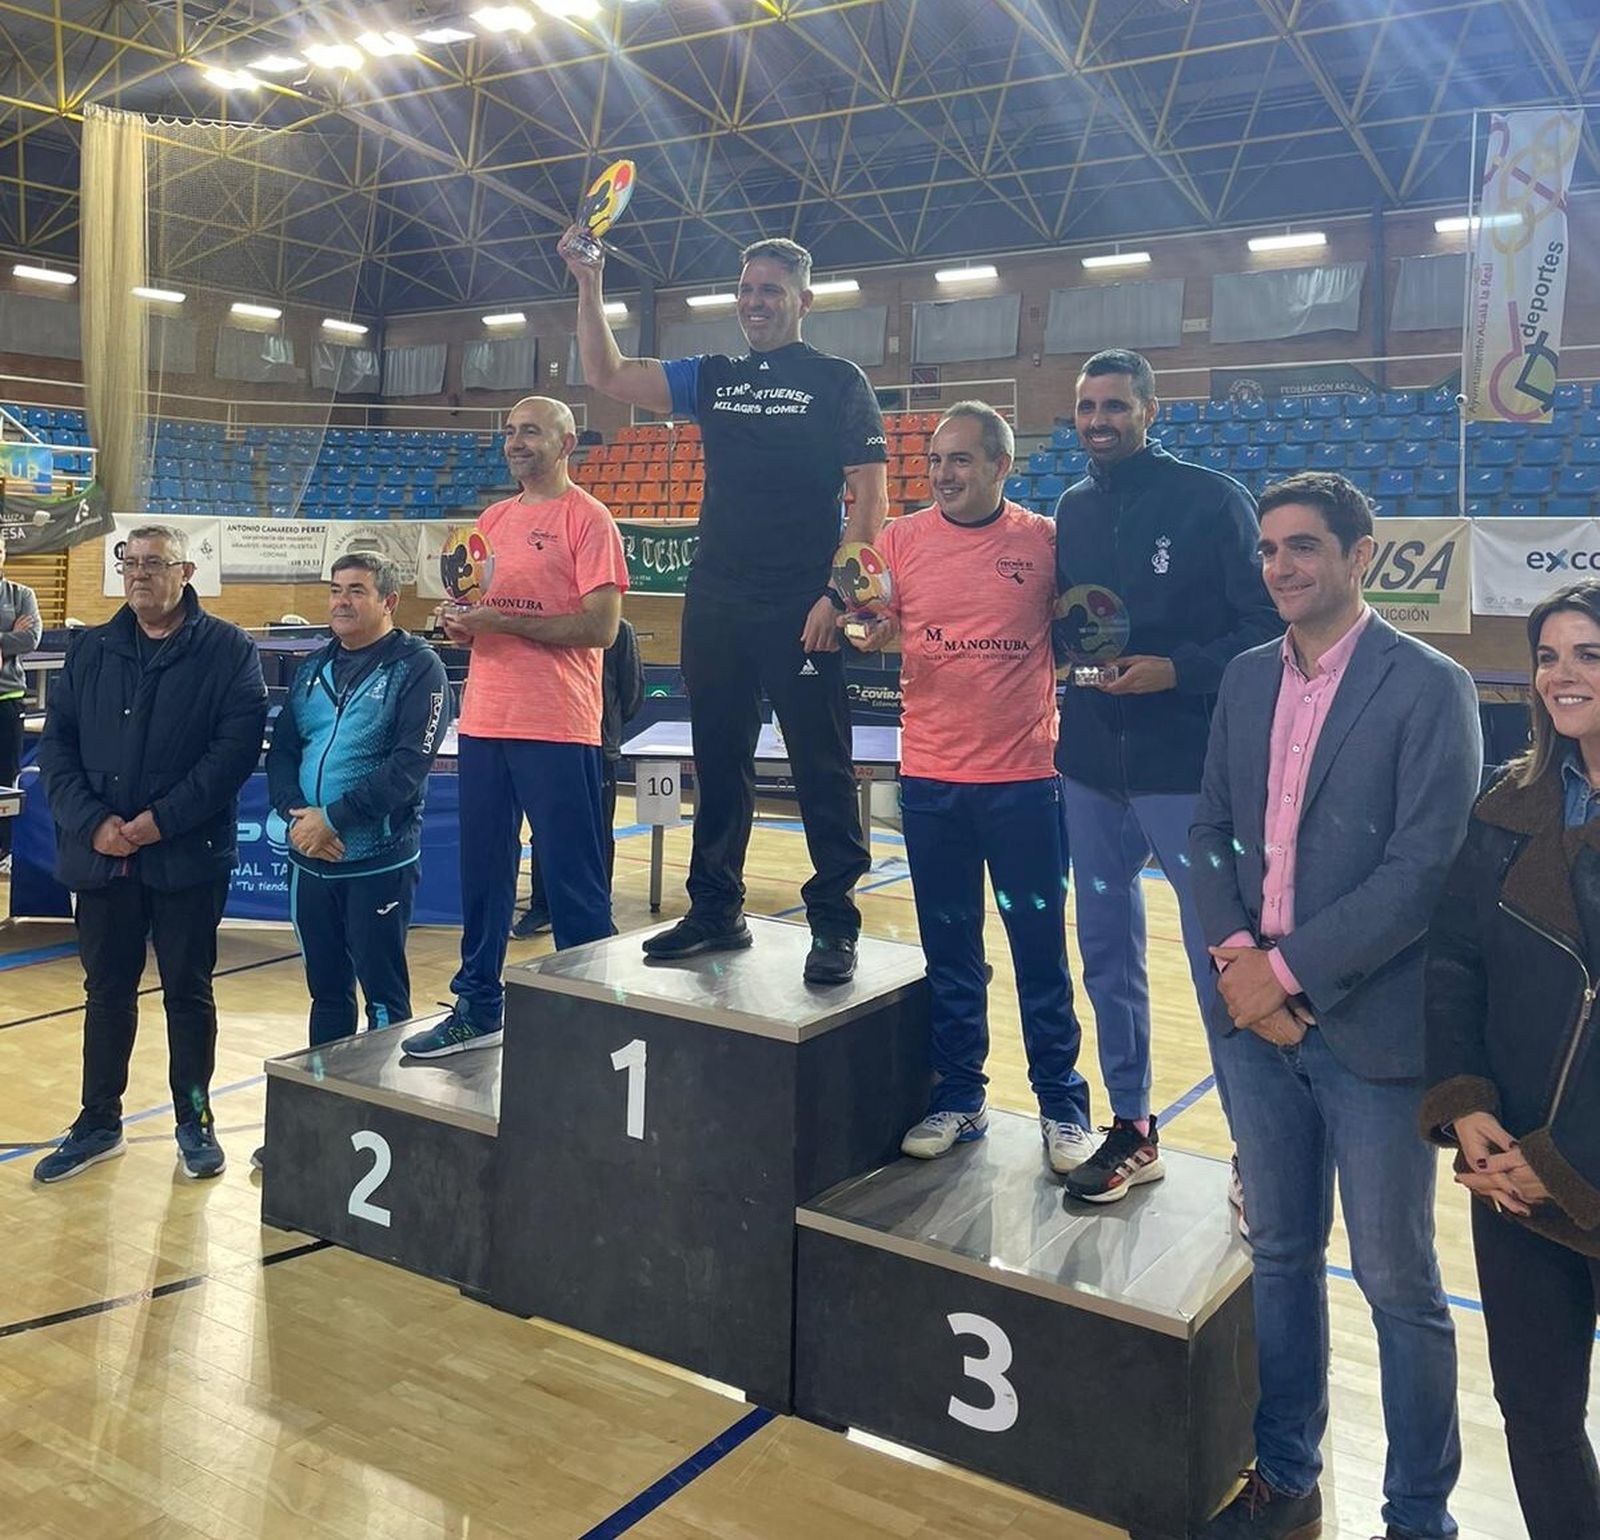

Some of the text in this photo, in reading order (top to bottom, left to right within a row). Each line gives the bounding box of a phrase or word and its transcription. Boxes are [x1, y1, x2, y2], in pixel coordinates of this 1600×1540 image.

[1520, 241, 1564, 337] deportes
[1468, 338, 1485, 414] Ayuntamiento
[227, 525, 260, 533] ANTONIO
[261, 526, 300, 534] CAMARERO
[1362, 541, 1455, 590] ISA
[944, 639, 1029, 651] MANONUBA
[648, 777, 674, 796] 10
[610, 1039, 647, 1140] 1
[348, 1130, 391, 1227] 2
[947, 1312, 1018, 1432] 3
